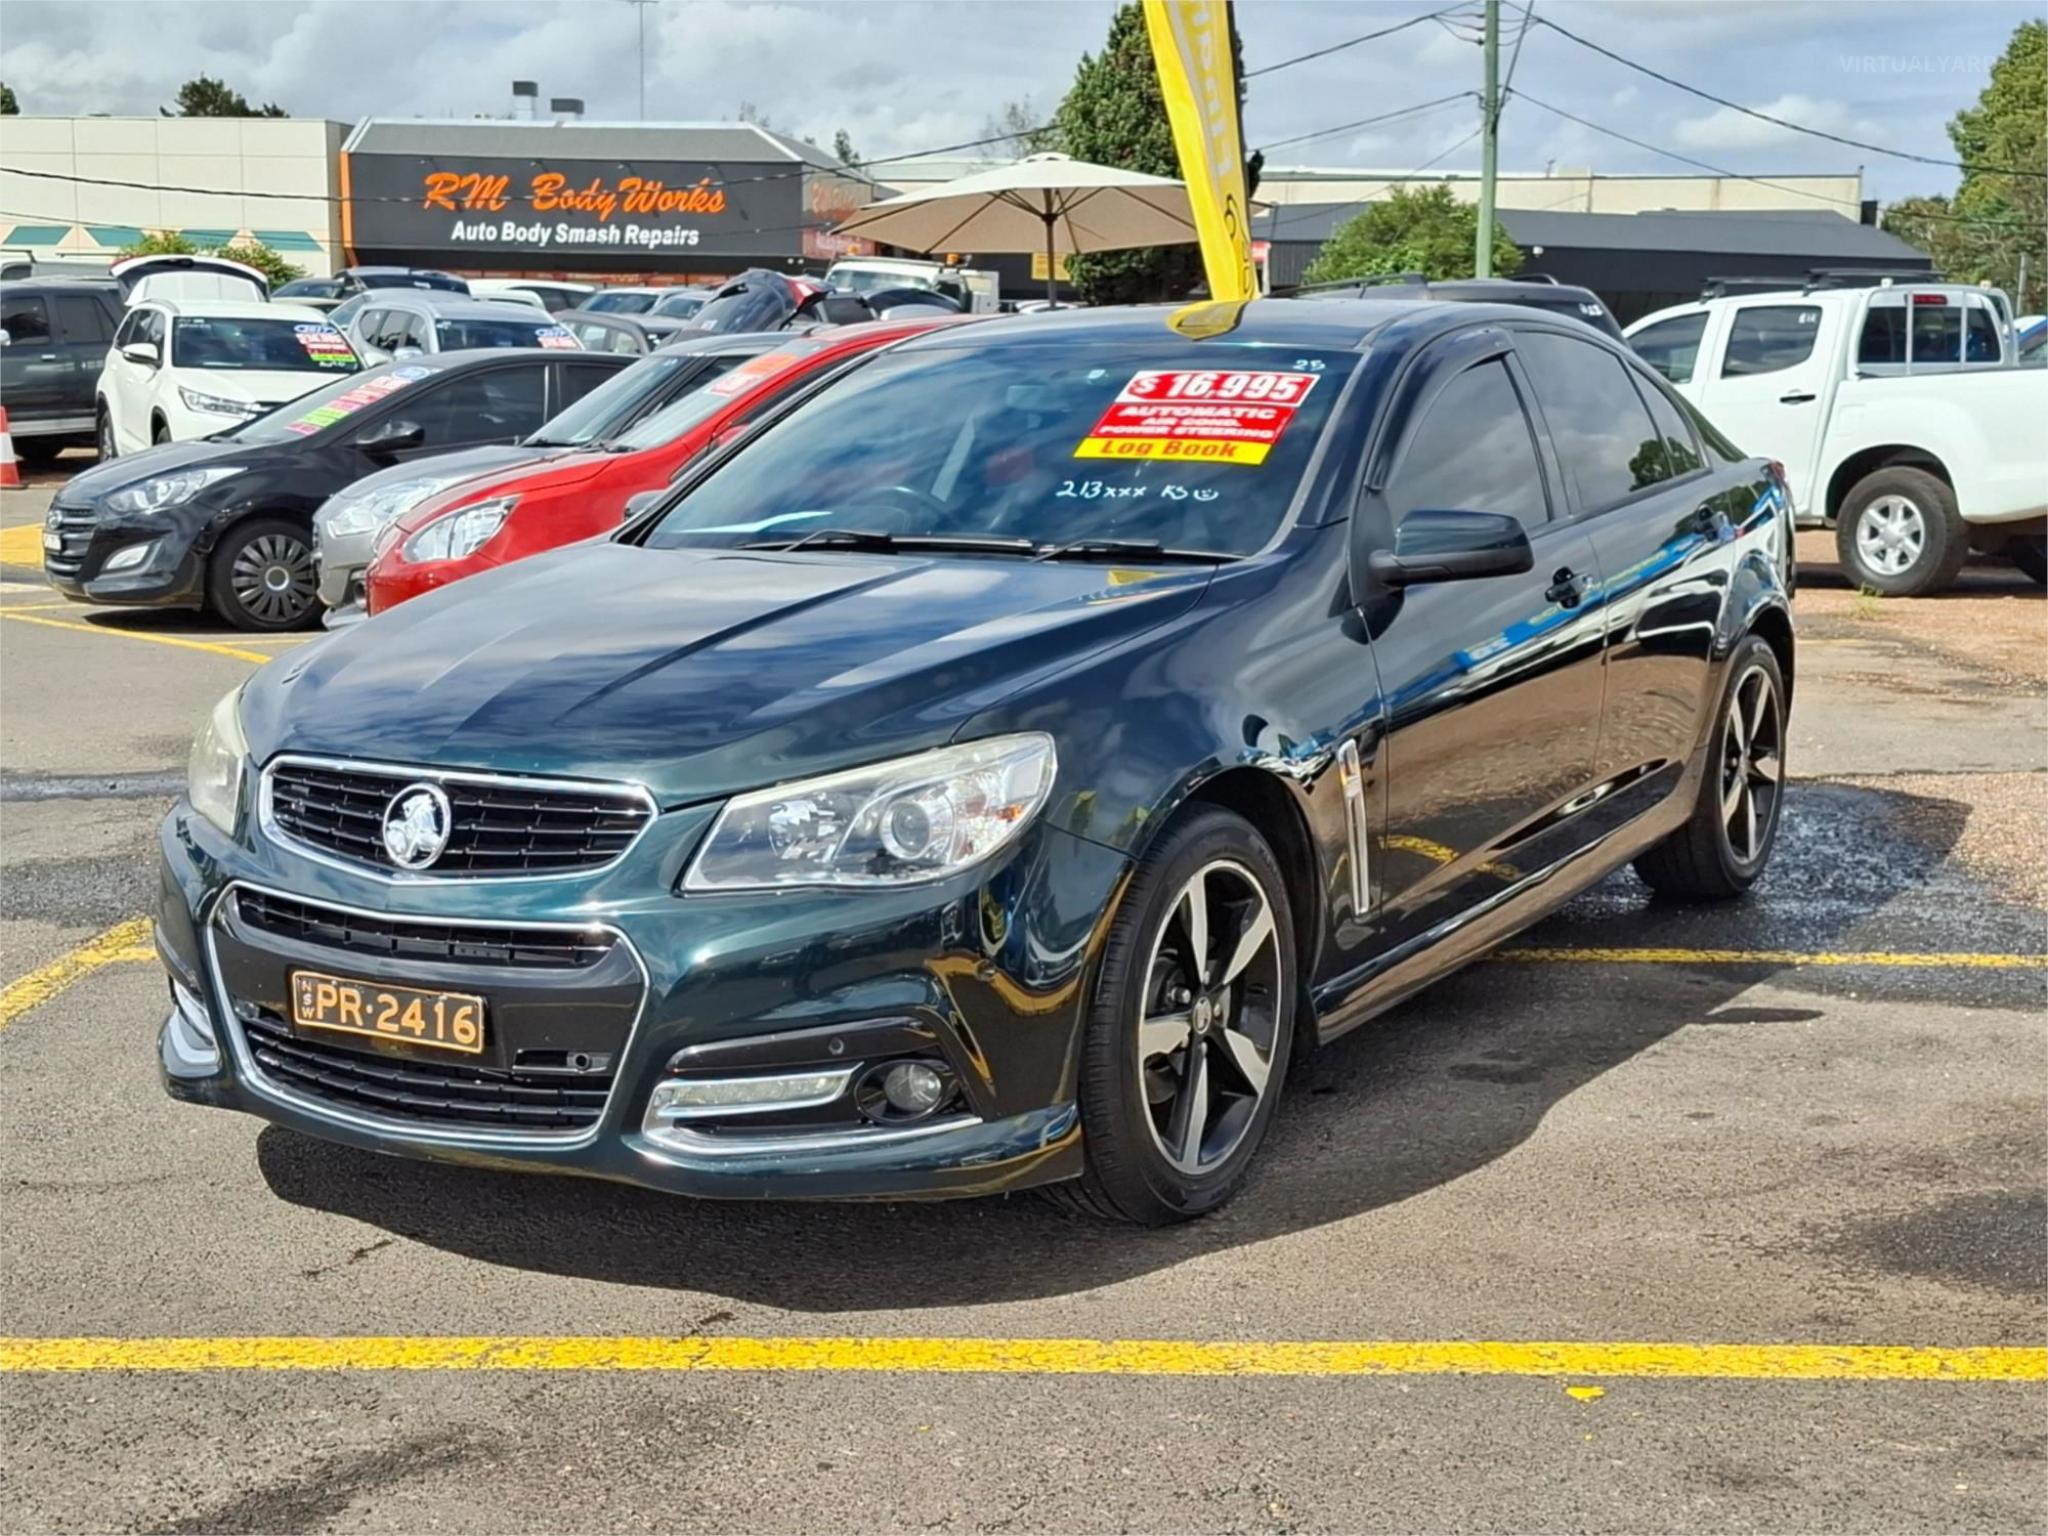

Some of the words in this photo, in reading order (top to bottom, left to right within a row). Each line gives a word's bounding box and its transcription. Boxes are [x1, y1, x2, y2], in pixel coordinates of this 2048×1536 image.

[424, 172, 510, 210] RM
[451, 220, 498, 241] Auto
[501, 222, 550, 246] Body
[555, 224, 621, 244] Smash
[624, 224, 700, 247] Repairs
[1135, 376, 1160, 393] $
[1166, 374, 1304, 400] 16,995
[1119, 406, 1278, 419] AUTOMATIC
[1142, 418, 1177, 426] AIR
[1099, 426, 1169, 435] POWER
[1173, 427, 1275, 440] STEERING
[1101, 440, 1152, 457] Log
[1163, 441, 1238, 458] Book
